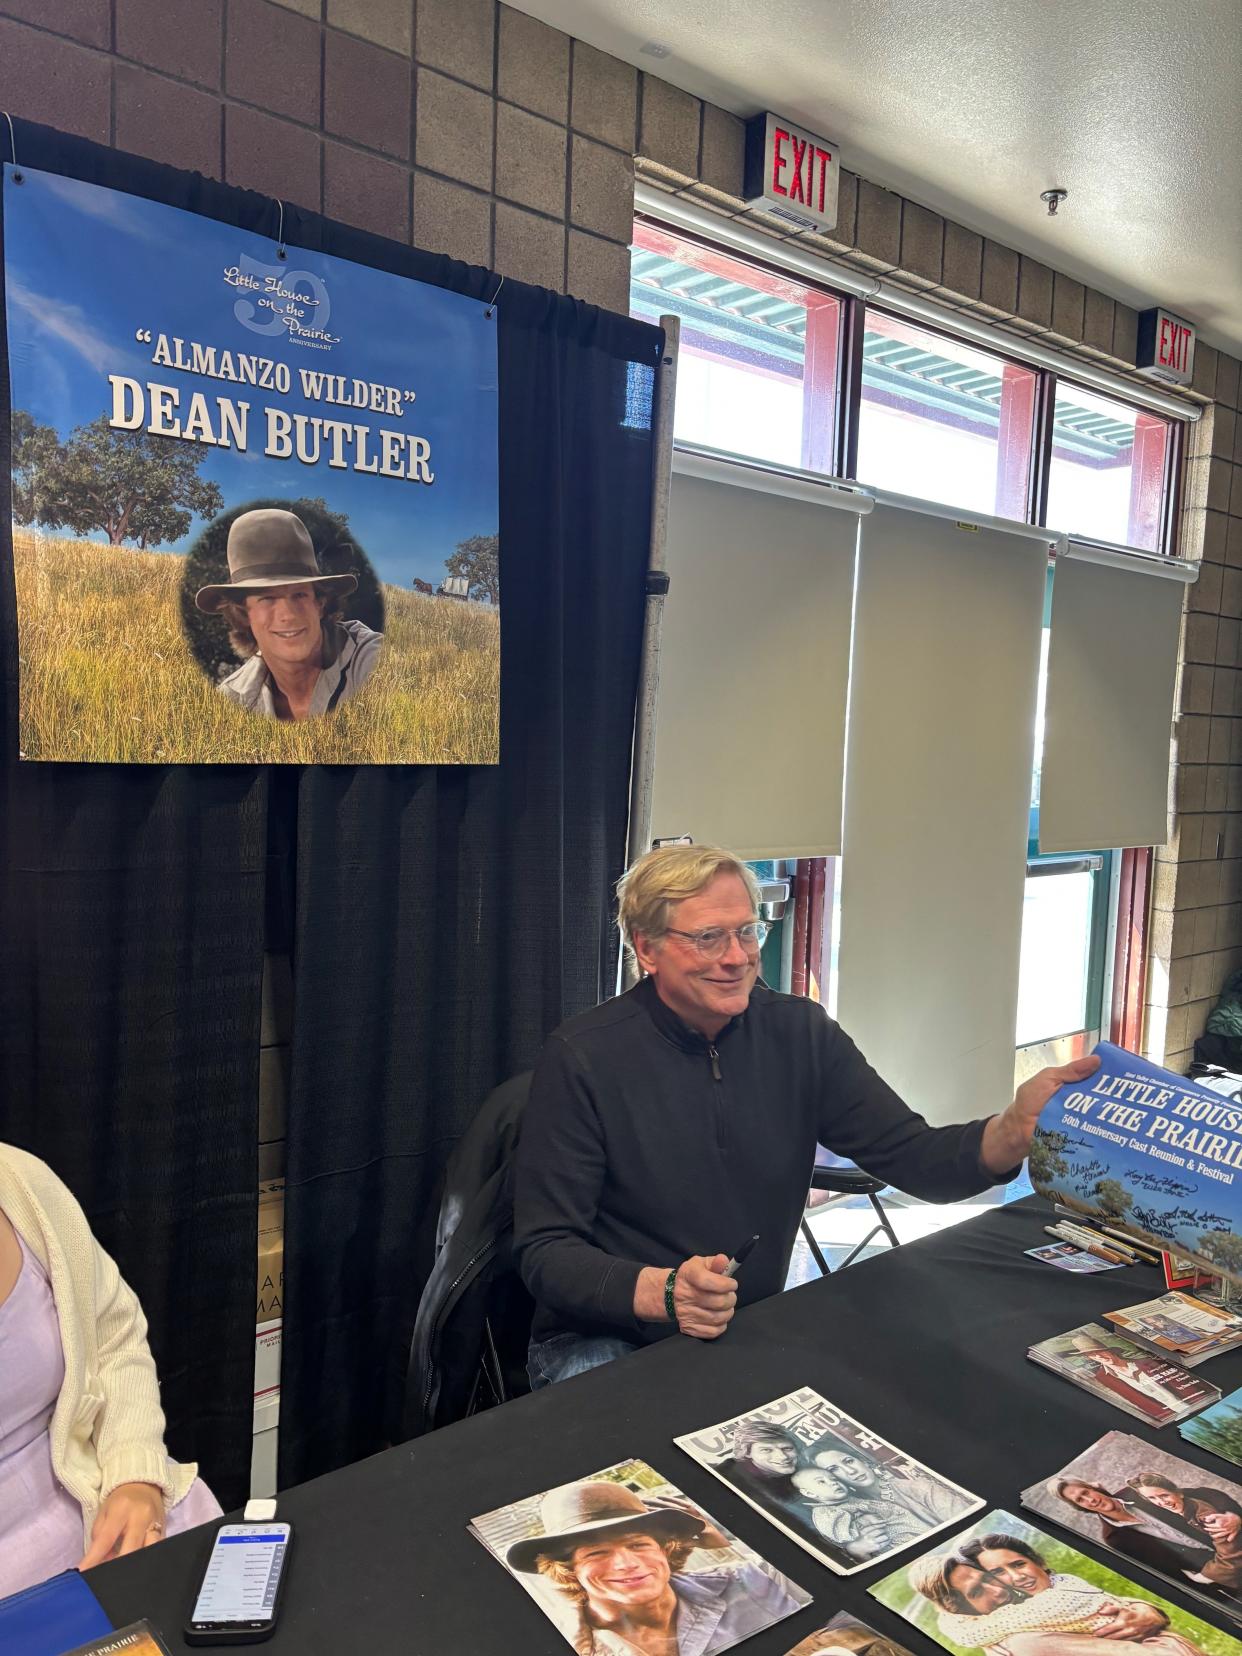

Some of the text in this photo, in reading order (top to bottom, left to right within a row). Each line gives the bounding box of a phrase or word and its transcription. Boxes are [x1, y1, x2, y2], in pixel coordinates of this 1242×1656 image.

[773, 126, 832, 213] EXIT
[223, 266, 320, 306] Little House
[258, 299, 305, 318] on the
[282, 316, 341, 344] Prairie
[288, 336, 332, 351] ANNIVERSARY
[1159, 317, 1192, 373] EXIT
[108, 374, 434, 485] DEAN BUTLER
[1063, 1092, 1099, 1114] ON
[1097, 1101, 1148, 1132] THE
[1092, 1074, 1242, 1135] LITTLE HOUS
[1061, 1114, 1080, 1128] 50th
[1080, 1121, 1129, 1147] Anniversary
[1128, 1138, 1148, 1153] Cast
[1149, 1144, 1186, 1167] Reunion
[1186, 1159, 1195, 1171] &
[1196, 1162, 1234, 1185] Festival
[97, 1633, 139, 1656] PRAIRIE
